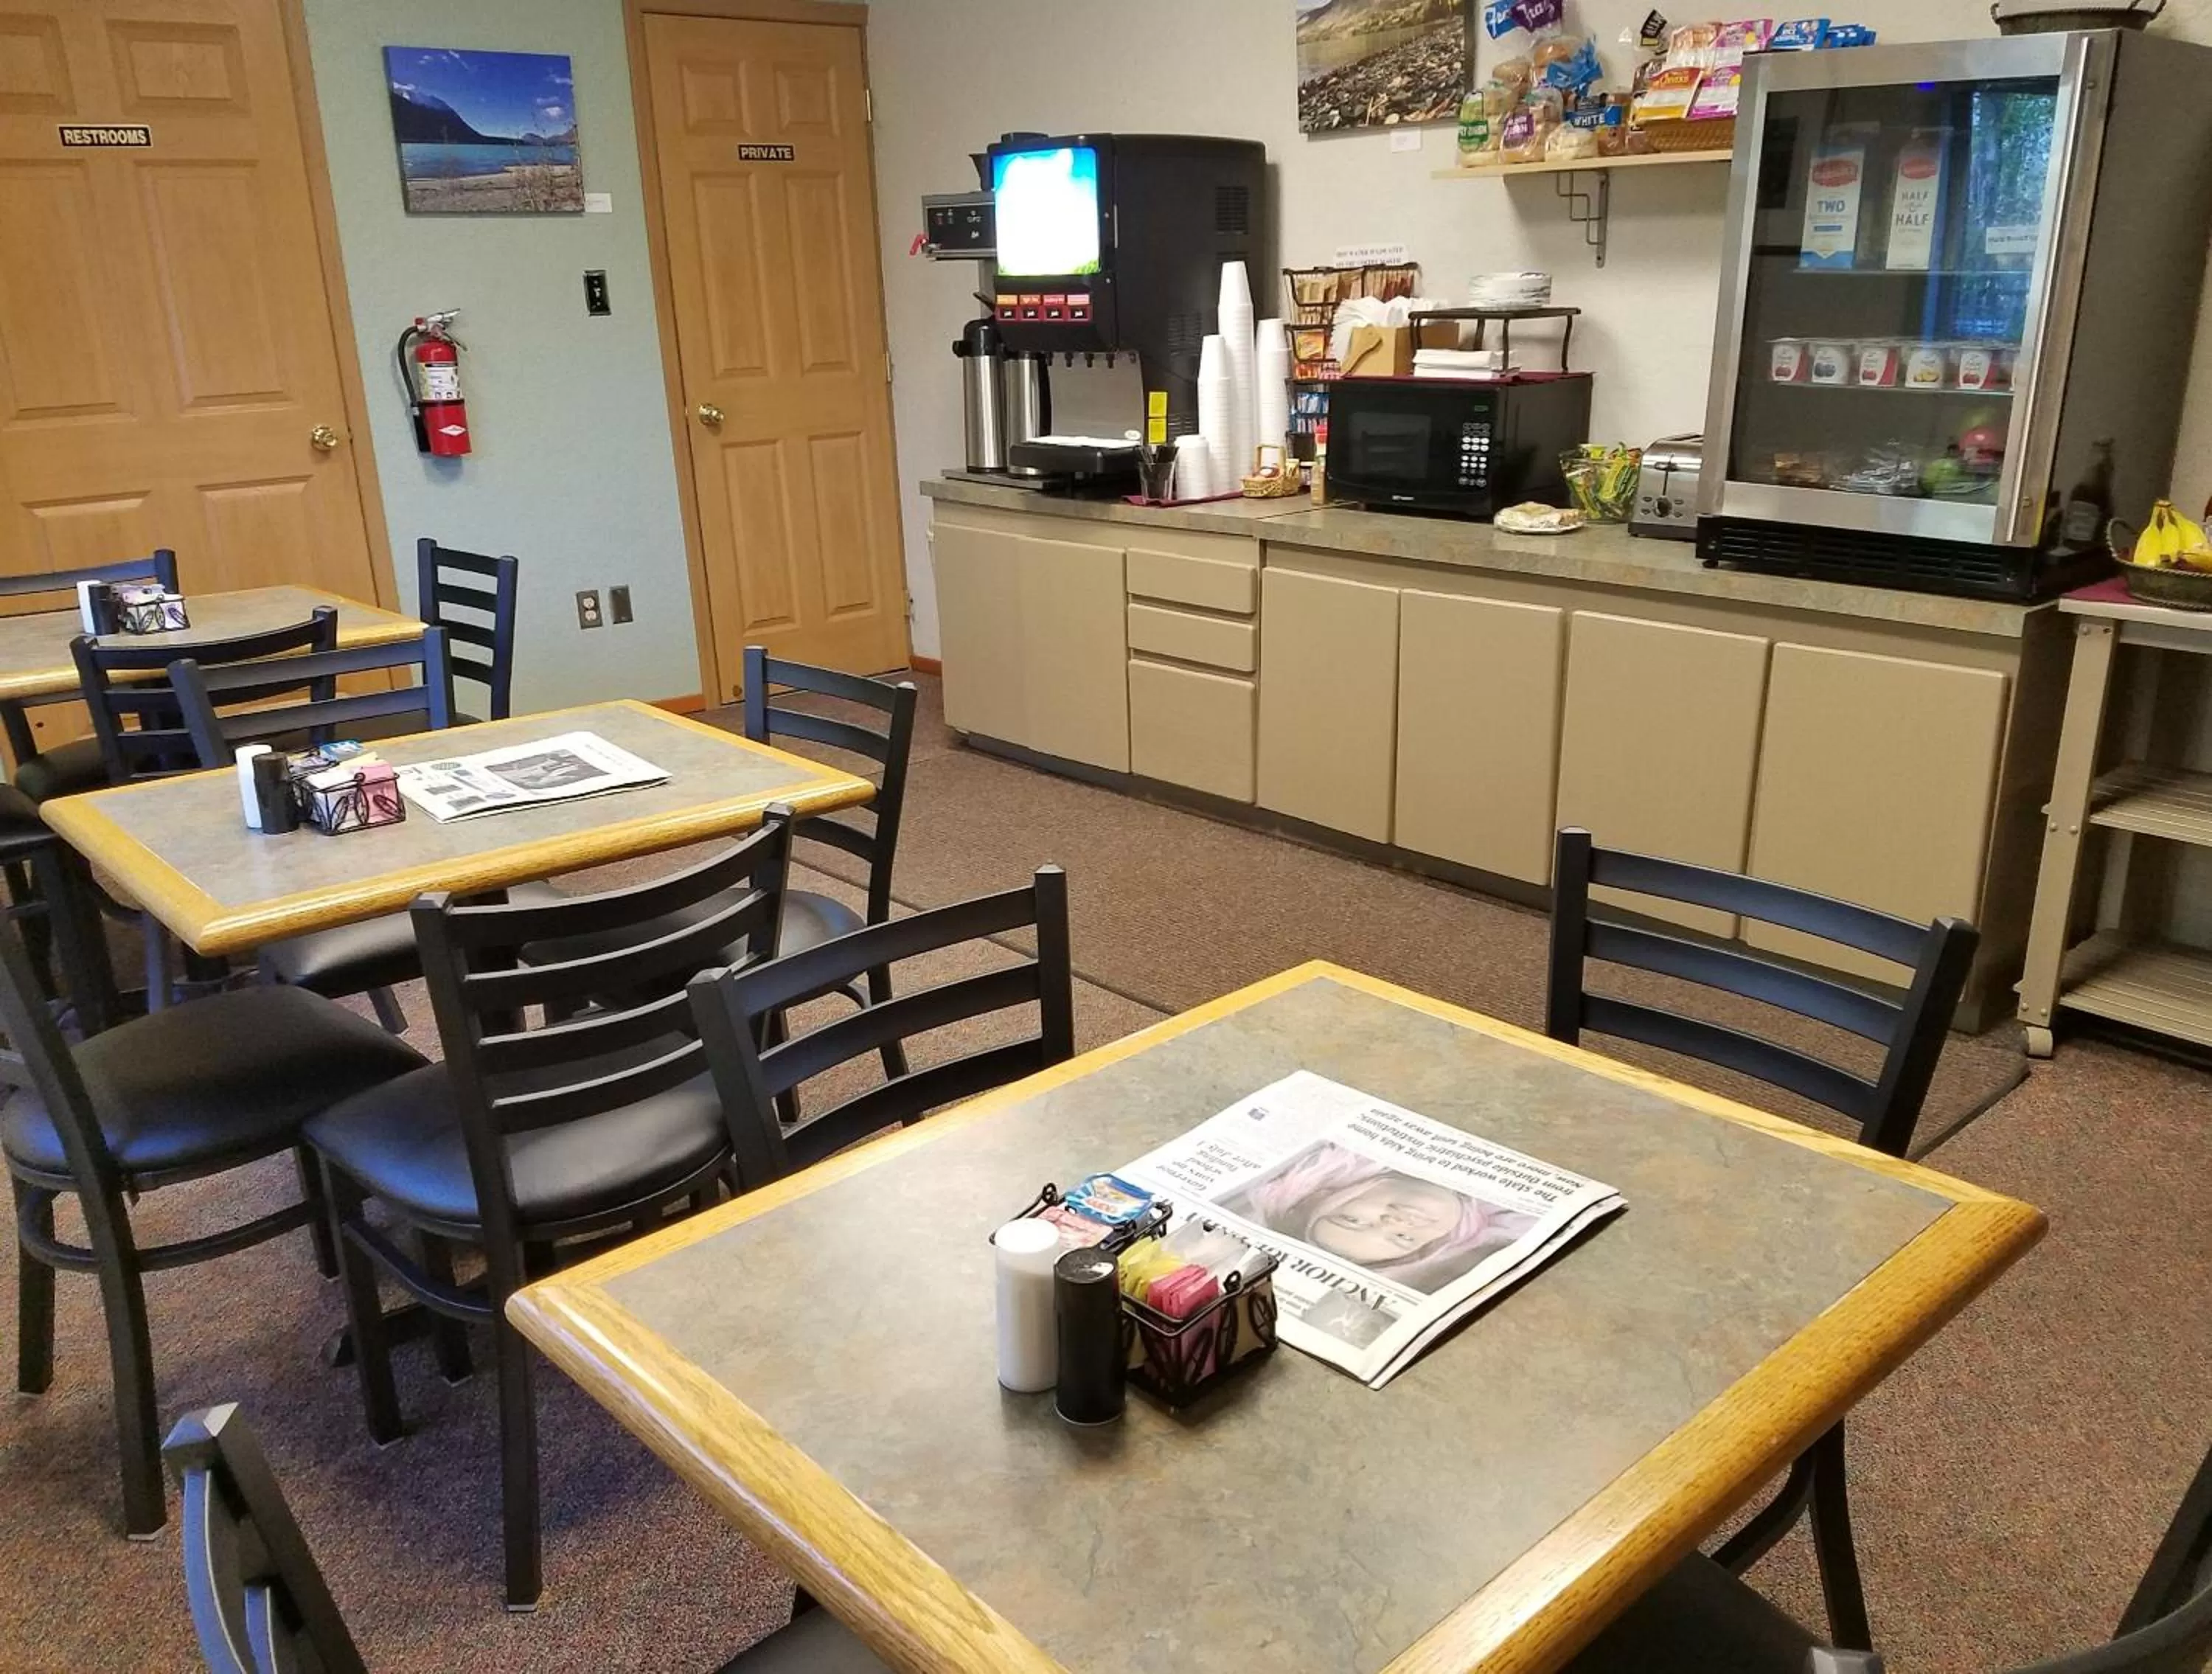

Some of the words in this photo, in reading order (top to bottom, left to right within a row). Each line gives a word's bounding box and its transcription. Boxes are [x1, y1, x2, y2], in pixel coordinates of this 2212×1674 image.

[1574, 113, 1605, 126] WHITE
[63, 129, 147, 145] RESTROOMS
[741, 147, 792, 159] PRIVATE
[1901, 190, 1929, 201] HALF
[1816, 200, 1846, 213] TWO
[1896, 213, 1930, 226] HALF
[1346, 1122, 1379, 1142] home
[1380, 1134, 1406, 1153] kids
[1404, 1145, 1437, 1165] bring
[1424, 1142, 1494, 1169] psychiatric
[1495, 1153, 1517, 1164] are
[1438, 1159, 1452, 1169] to
[1452, 1164, 1498, 1183] worked
[1496, 1164, 1541, 1184] Outside
[1498, 1178, 1531, 1193] state
[1542, 1178, 1576, 1197] from
[1534, 1188, 1559, 1204] The
